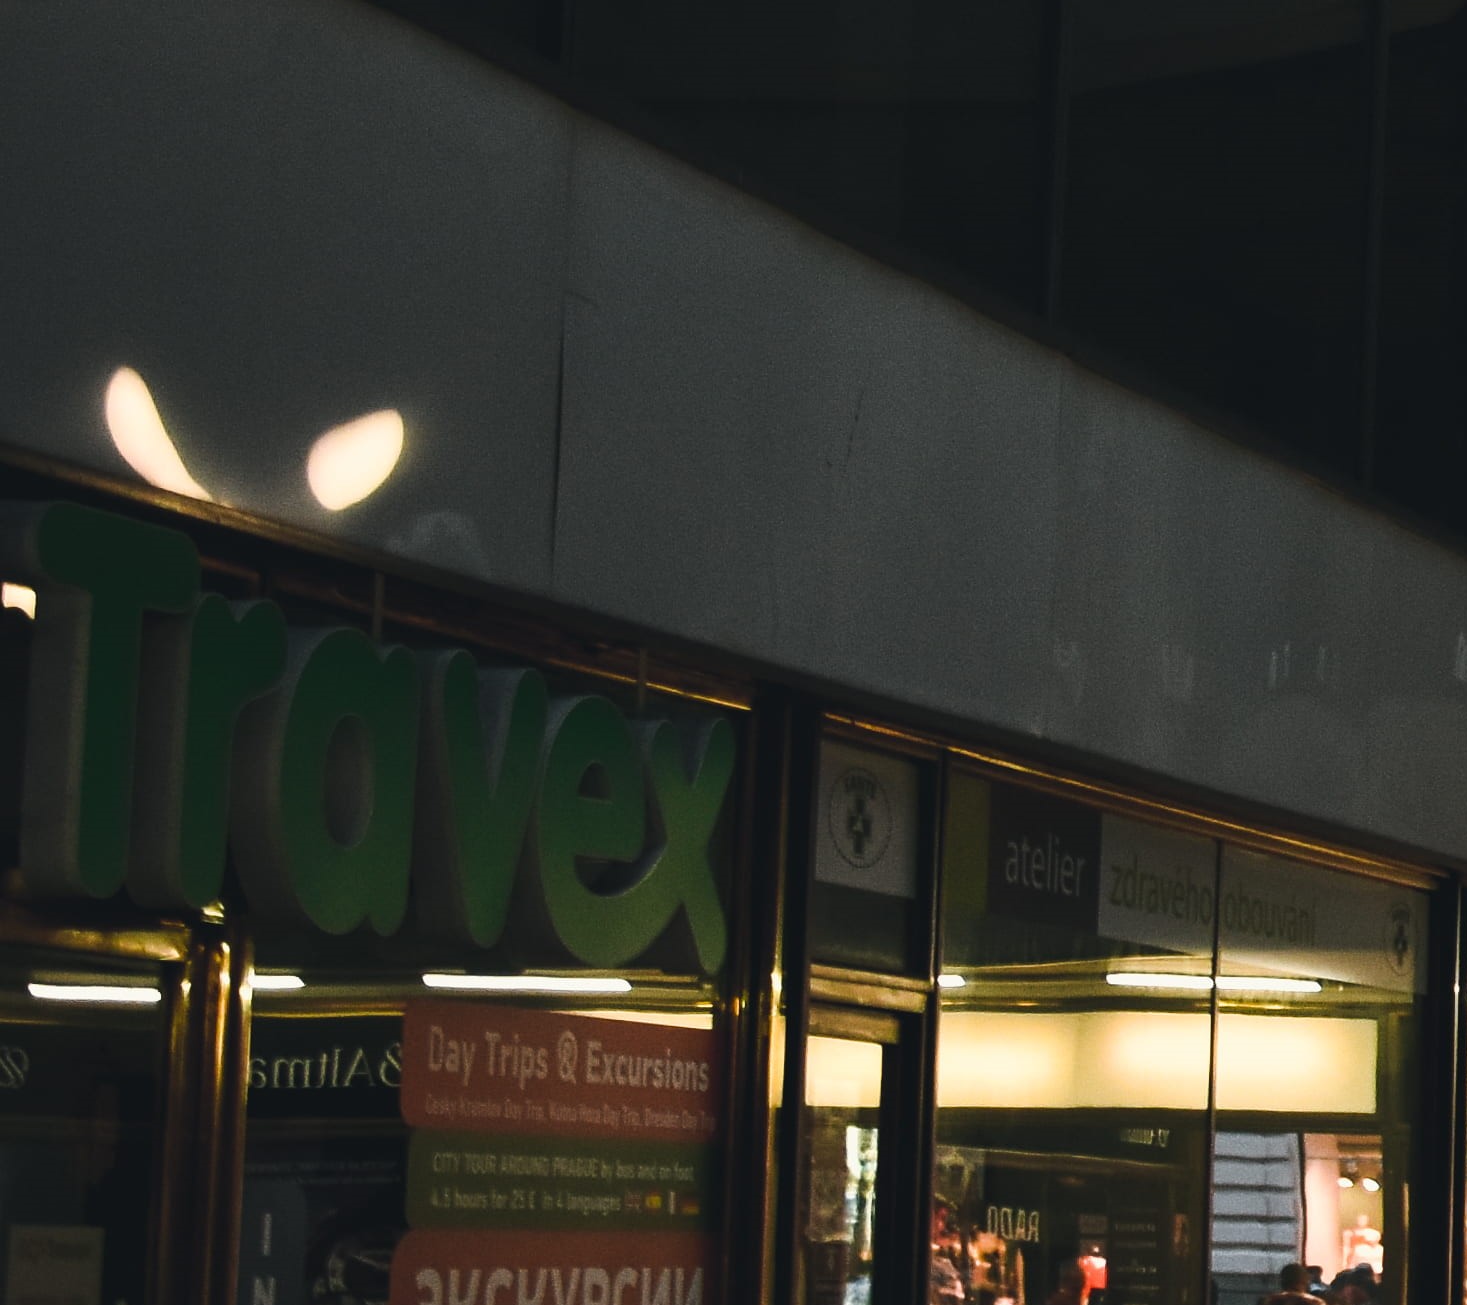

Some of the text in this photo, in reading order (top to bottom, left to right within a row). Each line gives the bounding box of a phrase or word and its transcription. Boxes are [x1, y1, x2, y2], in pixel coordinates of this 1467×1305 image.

[34, 500, 738, 977] Travex
[1005, 832, 1086, 899] atelier
[428, 1026, 475, 1088] Day
[485, 1031, 549, 1090] Trips
[586, 1039, 710, 1093] Excursions
